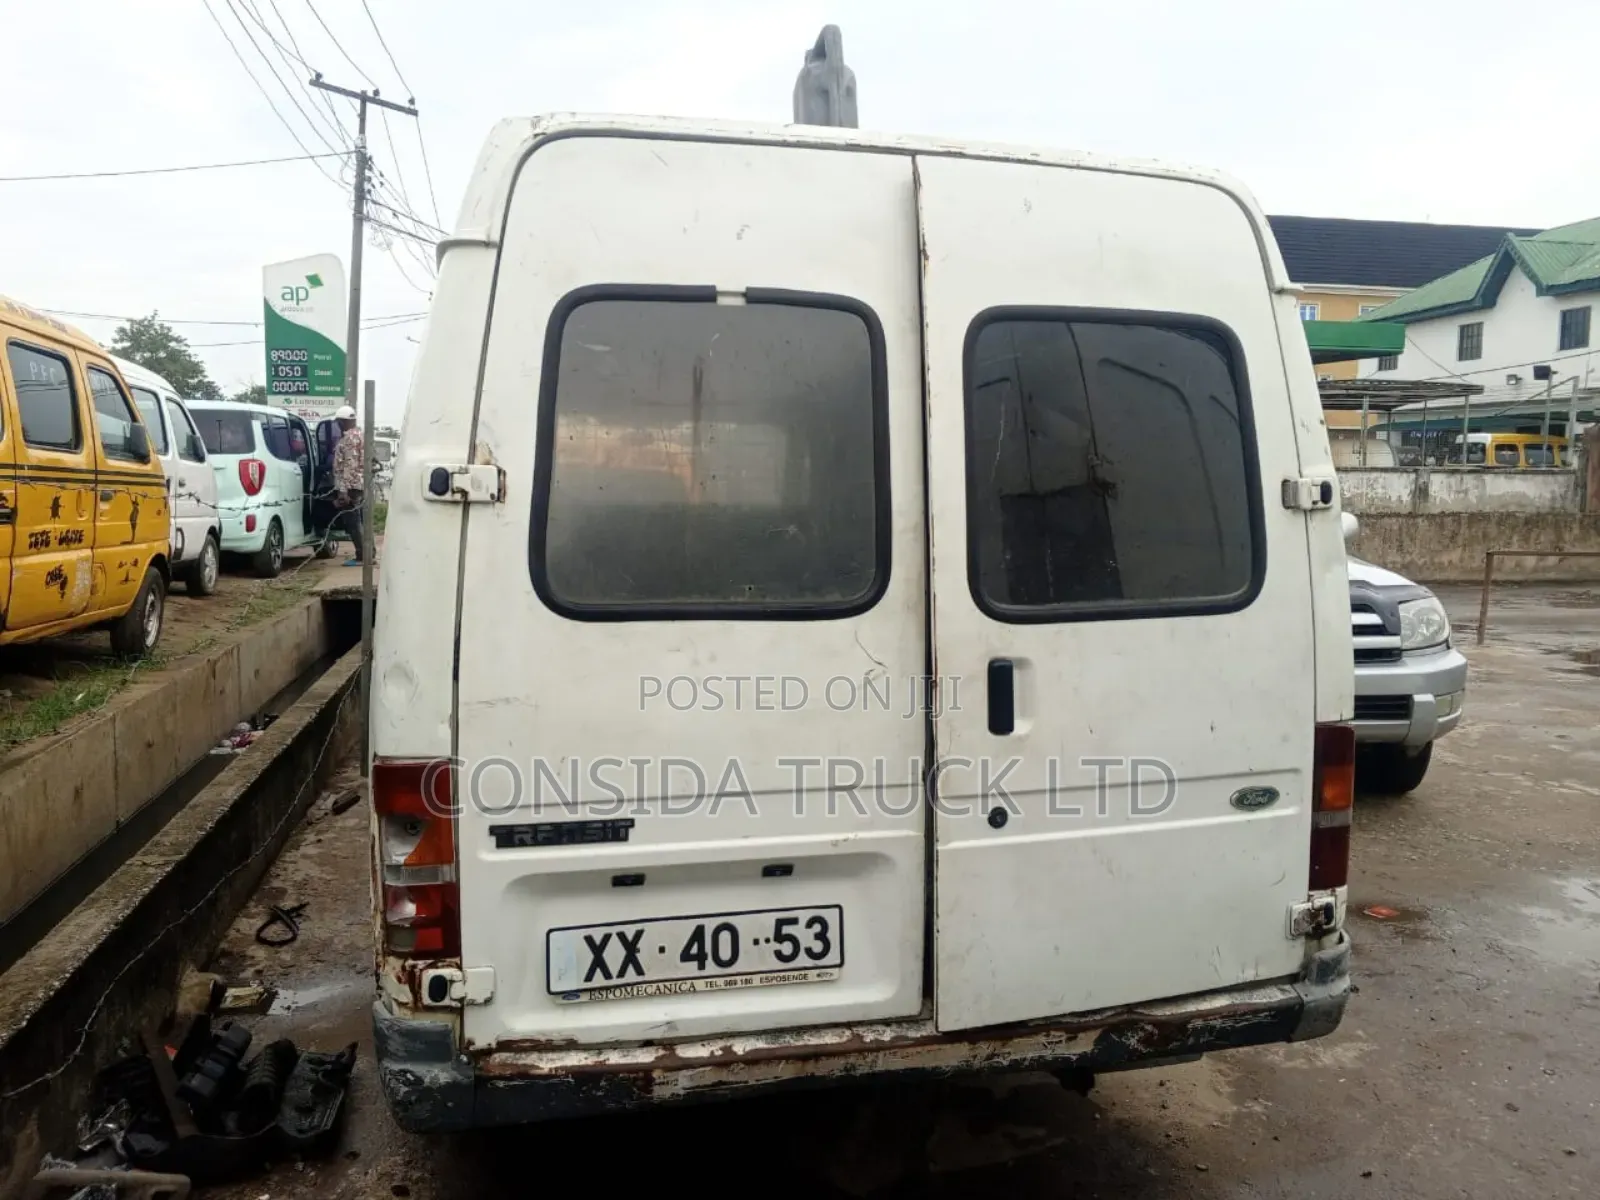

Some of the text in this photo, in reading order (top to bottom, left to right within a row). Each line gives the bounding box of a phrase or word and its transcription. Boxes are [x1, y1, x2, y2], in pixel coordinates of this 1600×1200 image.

[281, 286, 309, 306] ap
[588, 981, 697, 1001] ESPOMECANICA
[703, 979, 722, 989] TEL.
[759, 973, 809, 984] ESPOSENDE
